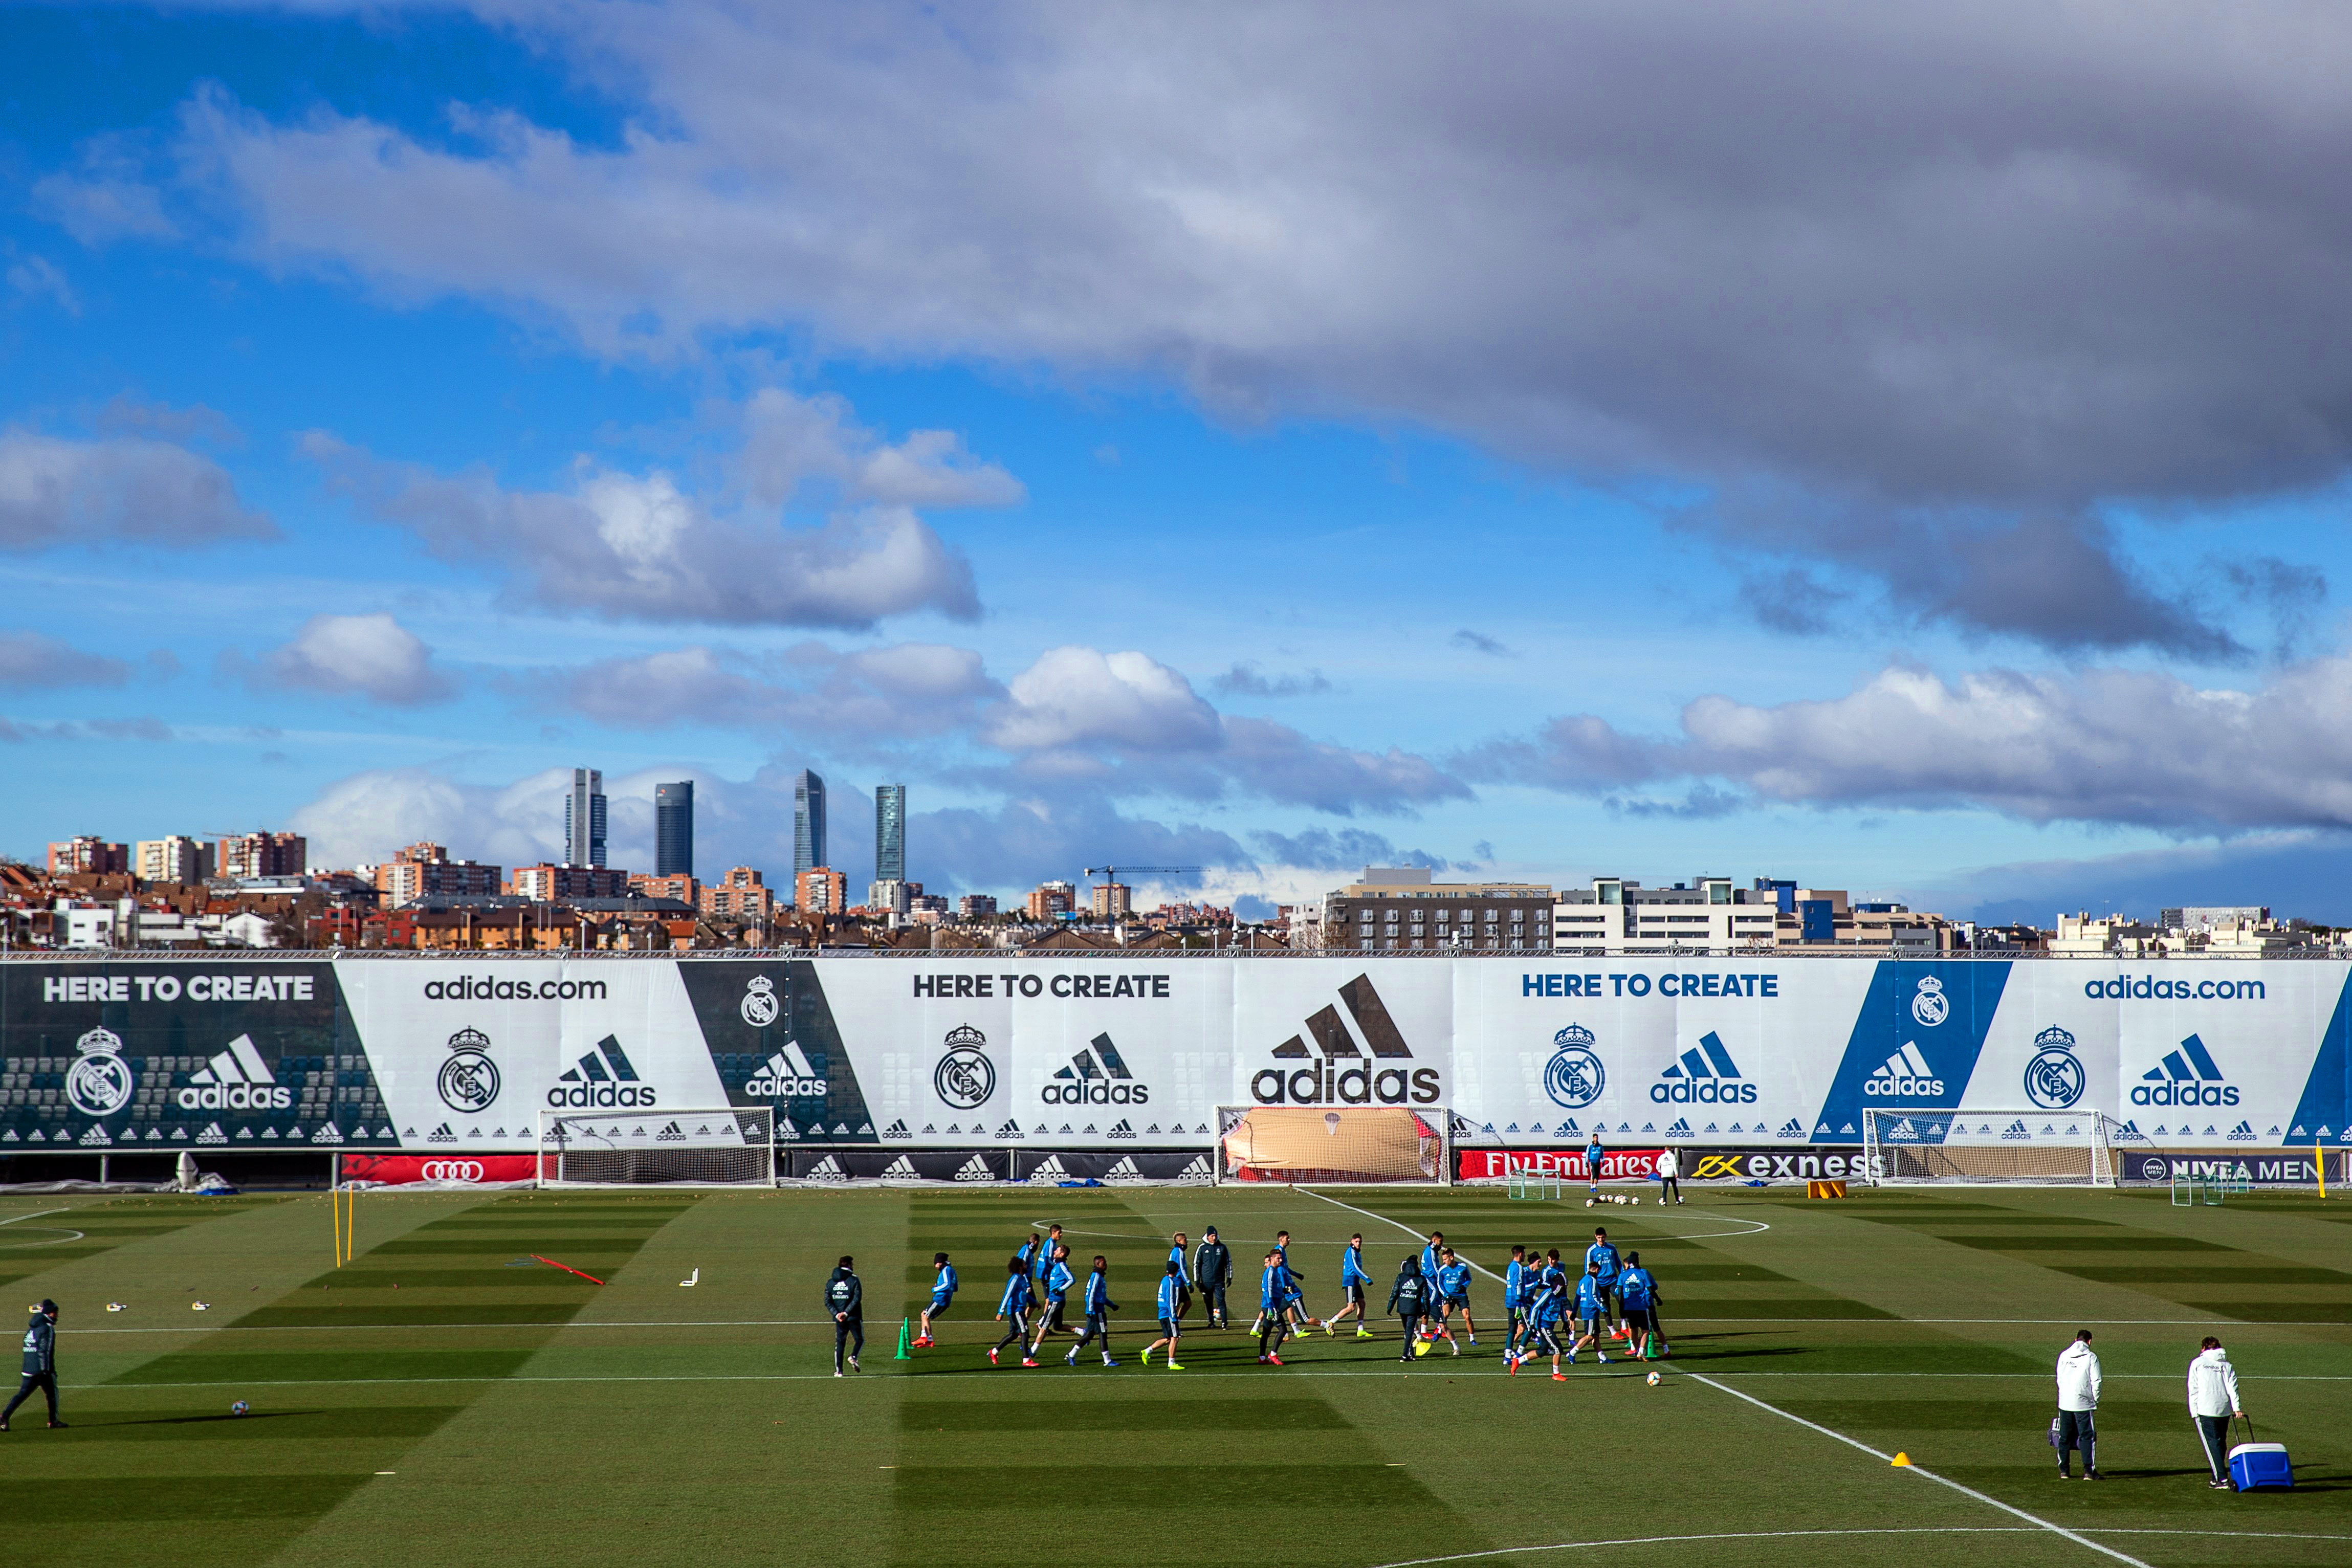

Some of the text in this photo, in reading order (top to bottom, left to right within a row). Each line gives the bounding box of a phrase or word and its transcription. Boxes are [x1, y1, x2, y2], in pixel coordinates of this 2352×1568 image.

[43, 976, 314, 1002] HERE TO CREATE
[425, 975, 607, 1000] adidas.com
[913, 975, 1170, 998] HERE TO CREATE
[1522, 974, 1778, 997] HERE TO CREATE
[2084, 975, 2265, 999] adidas.com
[745, 1075, 827, 1096] adidas
[1042, 1079, 1148, 1104] adidas
[1251, 1058, 1440, 1104] adidas
[1650, 1078, 1757, 1103] adidas
[1864, 1075, 1944, 1096] adidas
[178, 1081, 291, 1110] adidas
[547, 1081, 656, 1107] adidas
[2130, 1080, 2239, 1106] adidas
[79, 1137, 112, 1145] adidas
[773, 1131, 800, 1139] didas
[1448, 1130, 1471, 1138] didas
[1553, 1130, 1583, 1138] adidas
[1888, 1131, 1919, 1139] adidas
[2114, 1132, 2144, 1140] adidas
[1486, 1152, 1652, 1177] Fly Emiates
[1747, 1155, 1885, 1177] exness
[2172, 1160, 2319, 1180] NIVEA MEN
[806, 1172, 847, 1180] adidas
[955, 1172, 995, 1180] adidas
[1030, 1172, 1070, 1180] adidas
[1104, 1172, 1144, 1180] adidas
